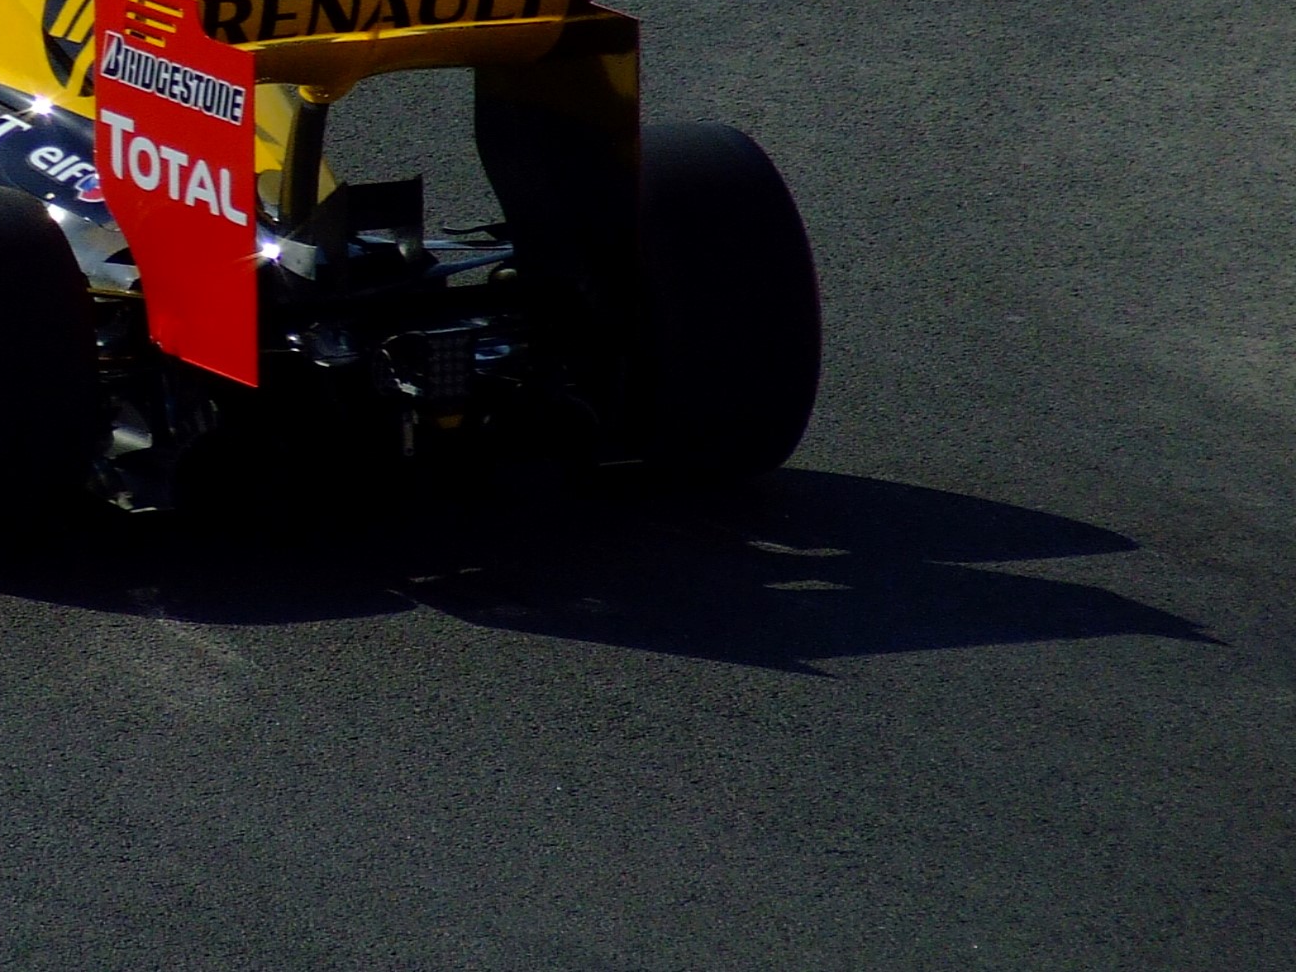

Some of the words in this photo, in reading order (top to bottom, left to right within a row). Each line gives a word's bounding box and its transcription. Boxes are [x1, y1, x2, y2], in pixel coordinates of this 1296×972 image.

[100, 30, 246, 126] BRIDGESTONE
[29, 145, 97, 182] elf
[101, 109, 248, 226] TOTAL
